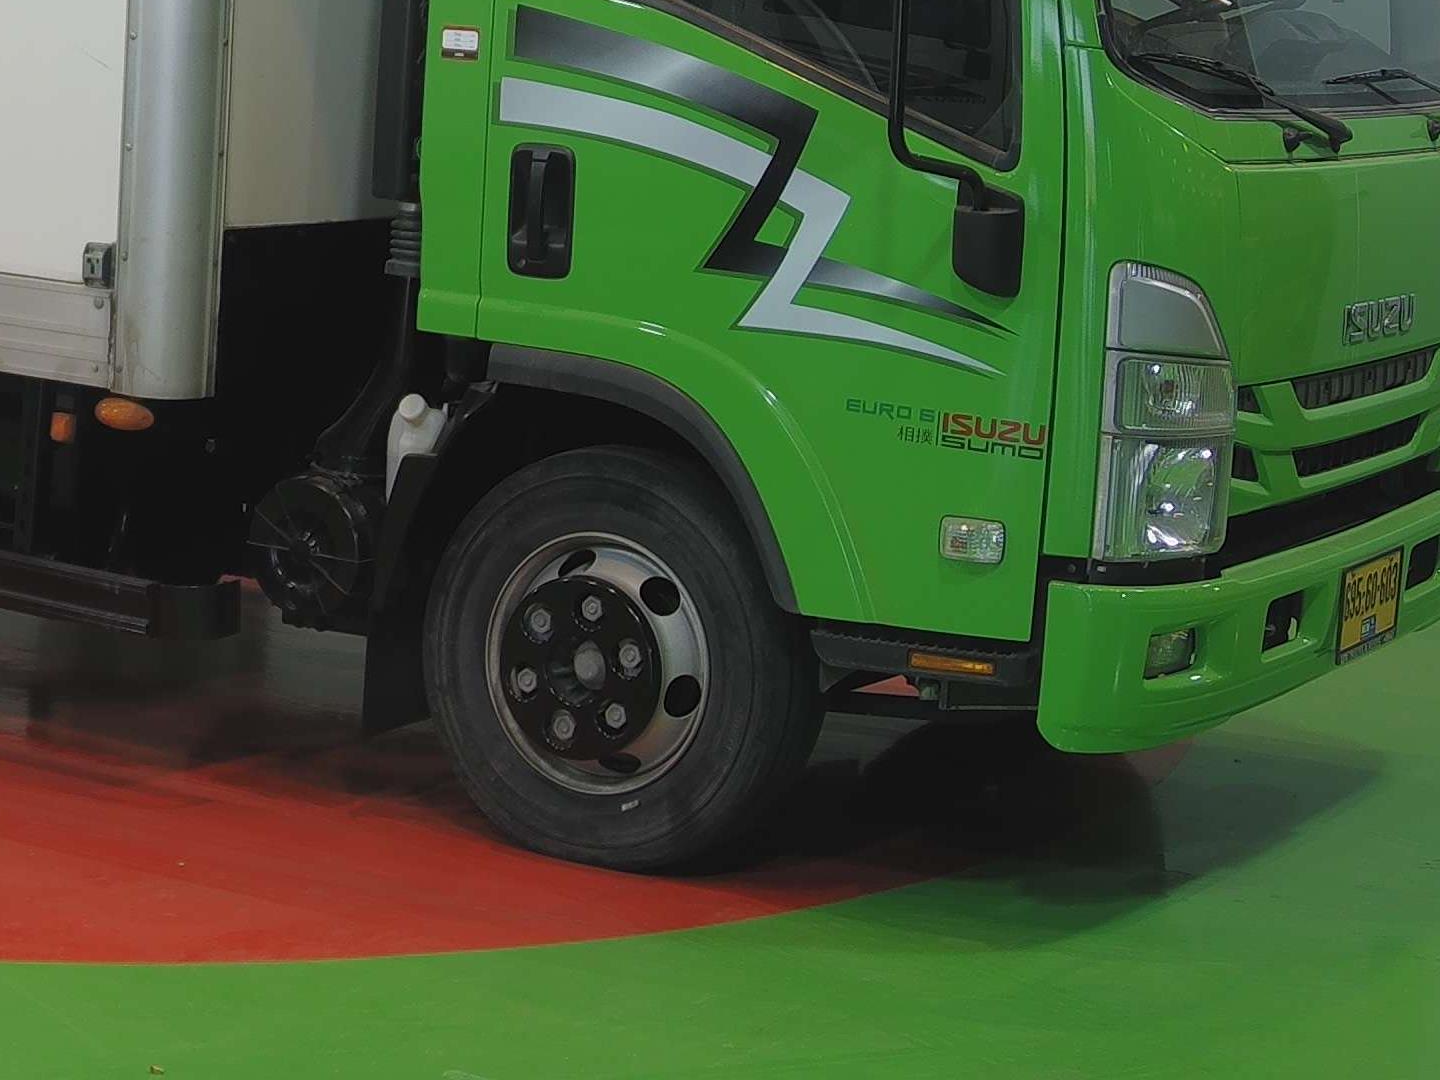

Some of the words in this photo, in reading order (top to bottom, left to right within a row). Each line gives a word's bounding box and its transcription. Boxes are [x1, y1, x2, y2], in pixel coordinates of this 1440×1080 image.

[1342, 293, 1415, 345] ISUZU
[846, 398, 911, 420] EURO
[942, 412, 1047, 445] ISUZU
[941, 434, 1045, 461] SUMO
